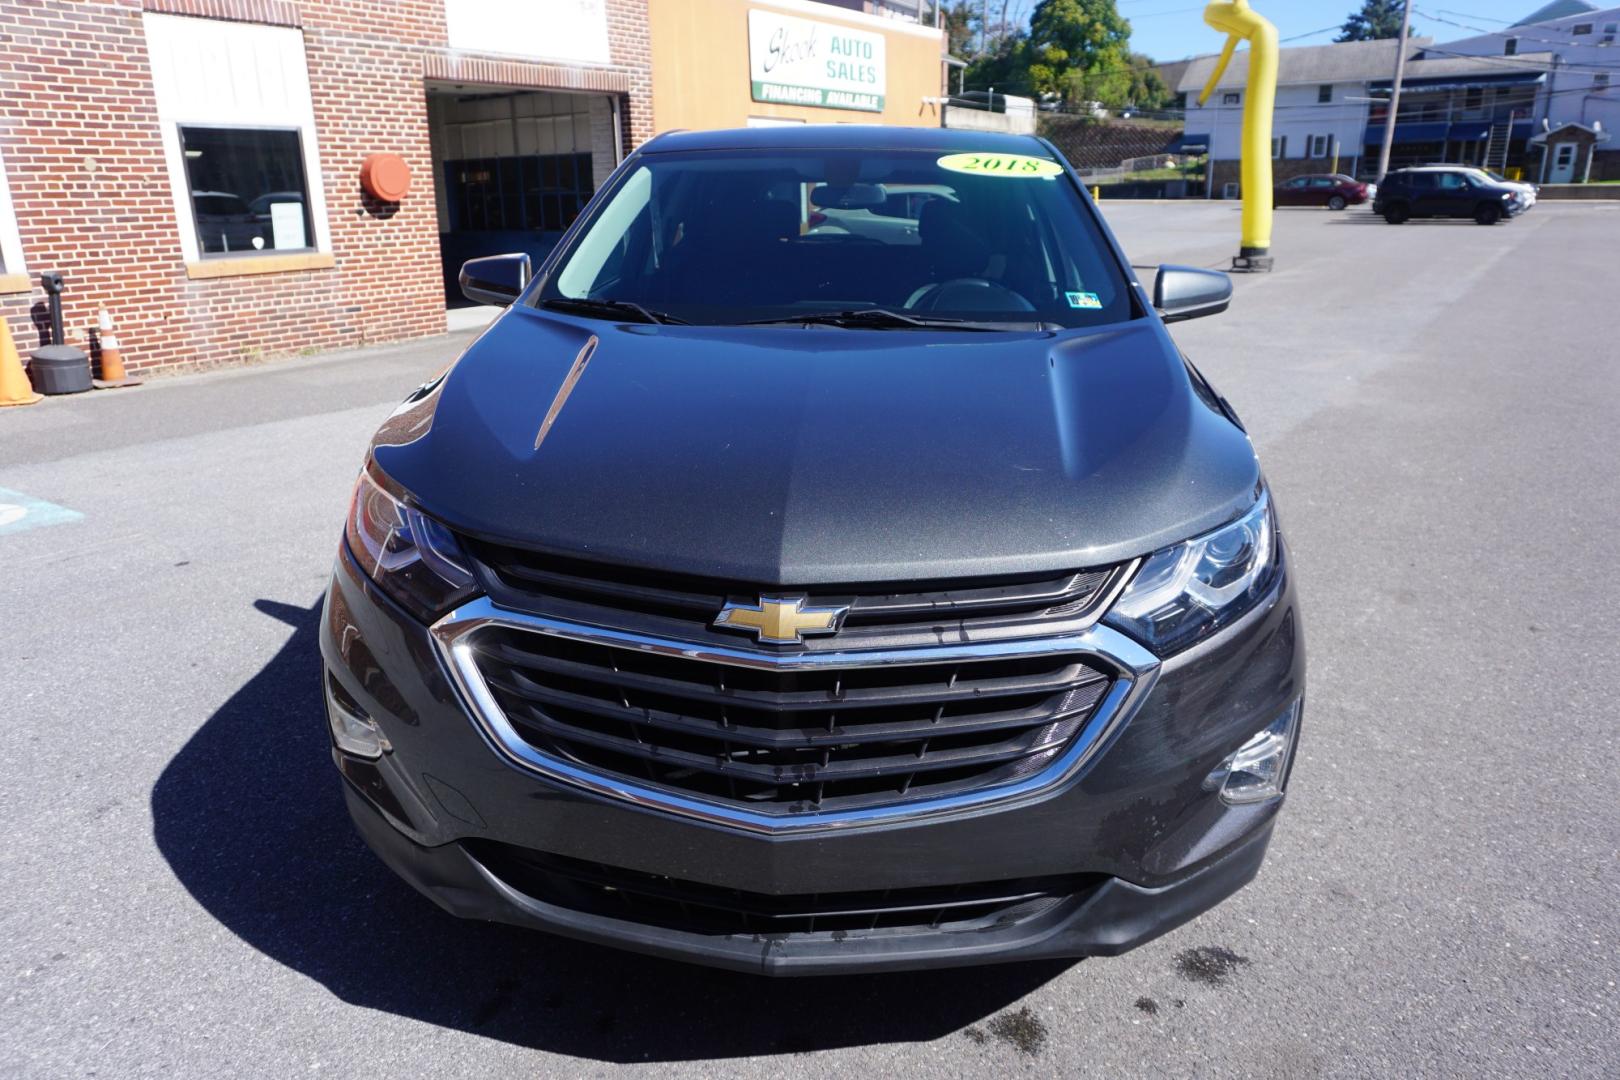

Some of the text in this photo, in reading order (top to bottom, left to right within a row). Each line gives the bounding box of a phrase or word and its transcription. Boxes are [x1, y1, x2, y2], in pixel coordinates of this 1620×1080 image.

[831, 36, 873, 60] AUTO
[826, 60, 876, 84] SALES
[762, 83, 879, 109] FINANCING AVAILABLE
[963, 157, 1040, 172] 2018
